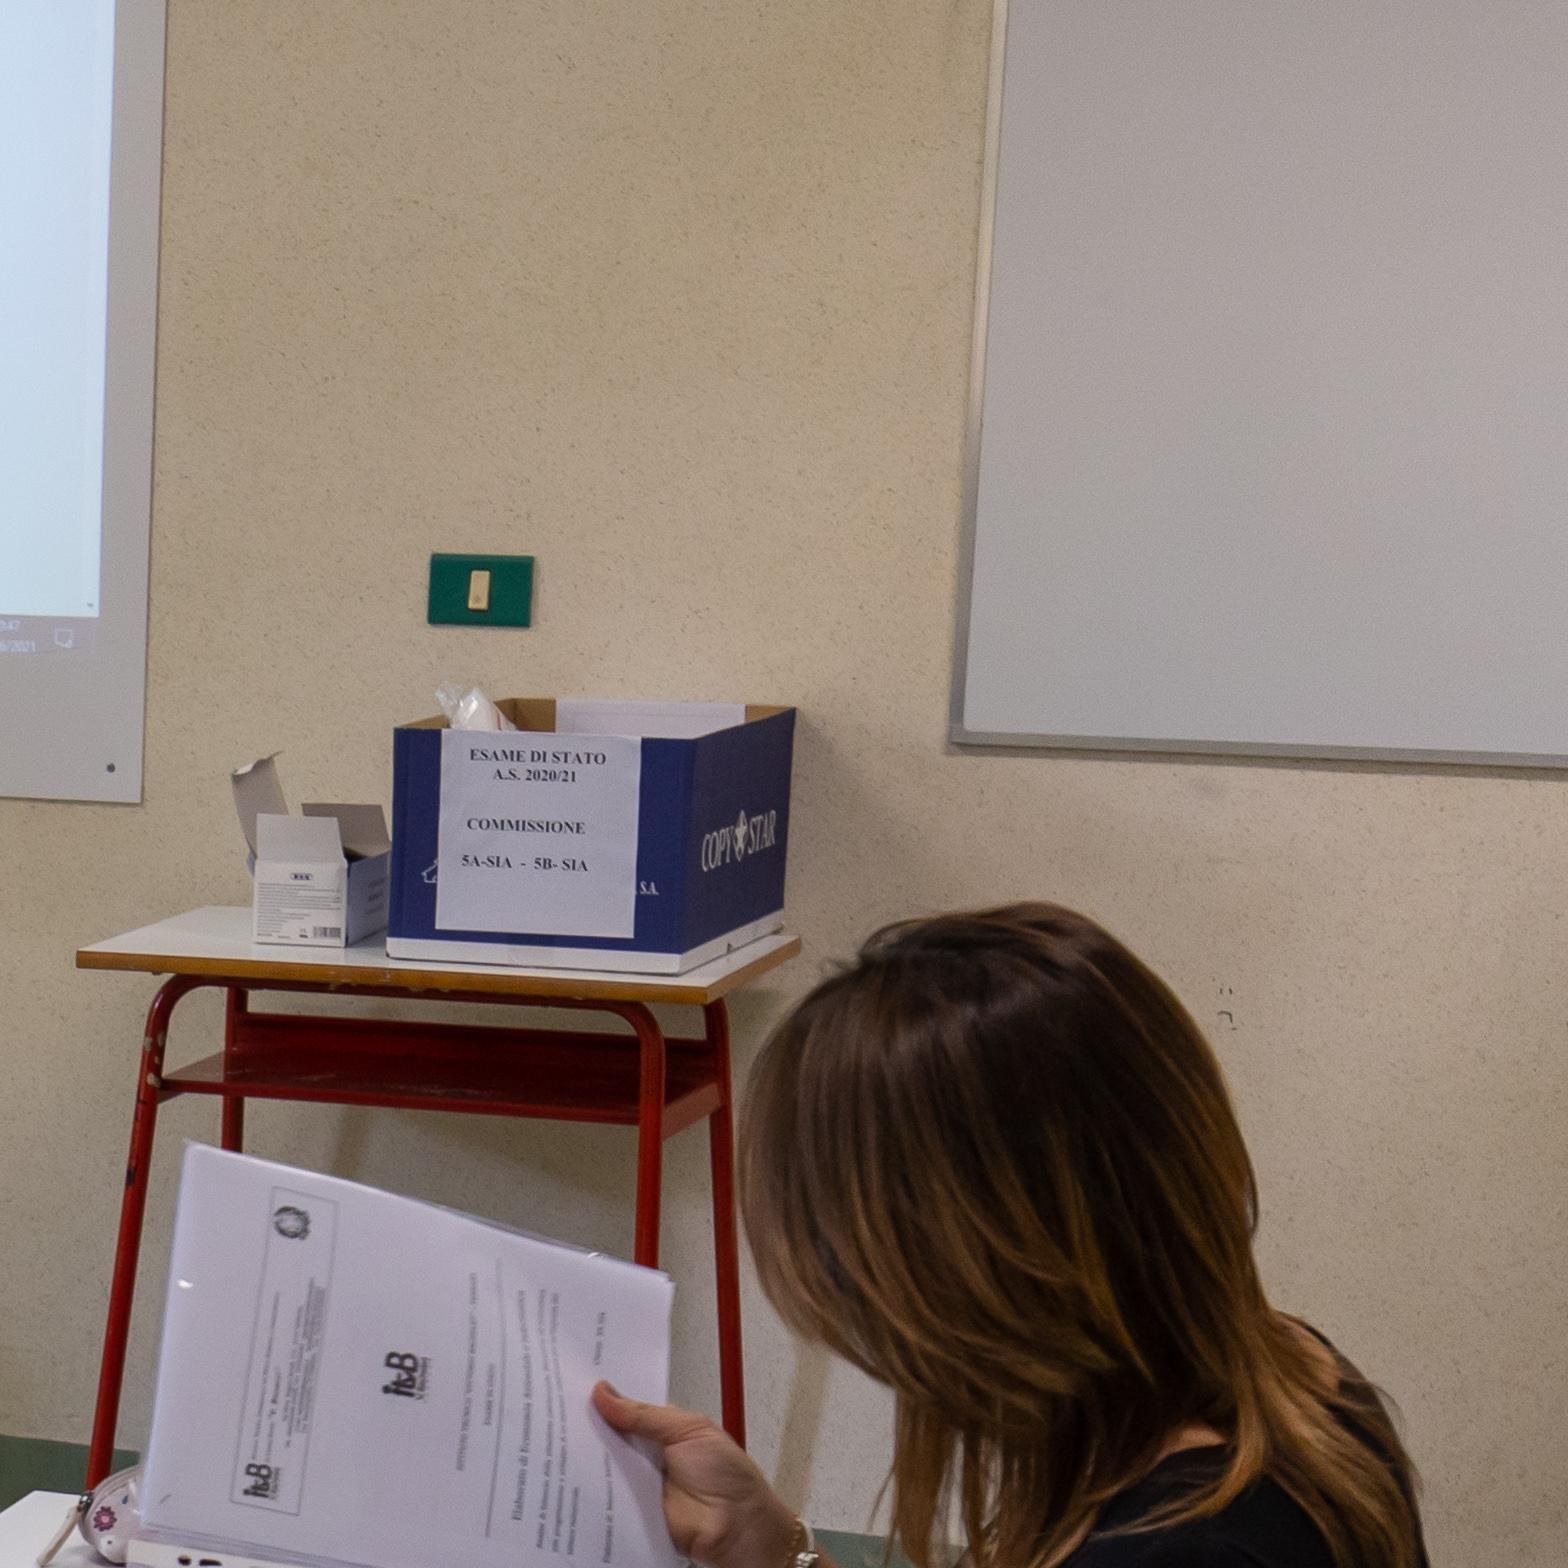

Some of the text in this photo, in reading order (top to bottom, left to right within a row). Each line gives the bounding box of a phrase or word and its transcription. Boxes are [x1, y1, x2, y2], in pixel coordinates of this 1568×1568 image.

[470, 749, 606, 765] ESAME DI STATO
[493, 769, 576, 782] A.S. 2020/21
[467, 818, 585, 834] COMMISSIONE
[702, 809, 776, 872] COPY STAR
[462, 855, 512, 868] 5A-SIA
[534, 858, 557, 869] 5B-
[562, 858, 588, 871] SIA
[640, 880, 660, 895] S.A.
